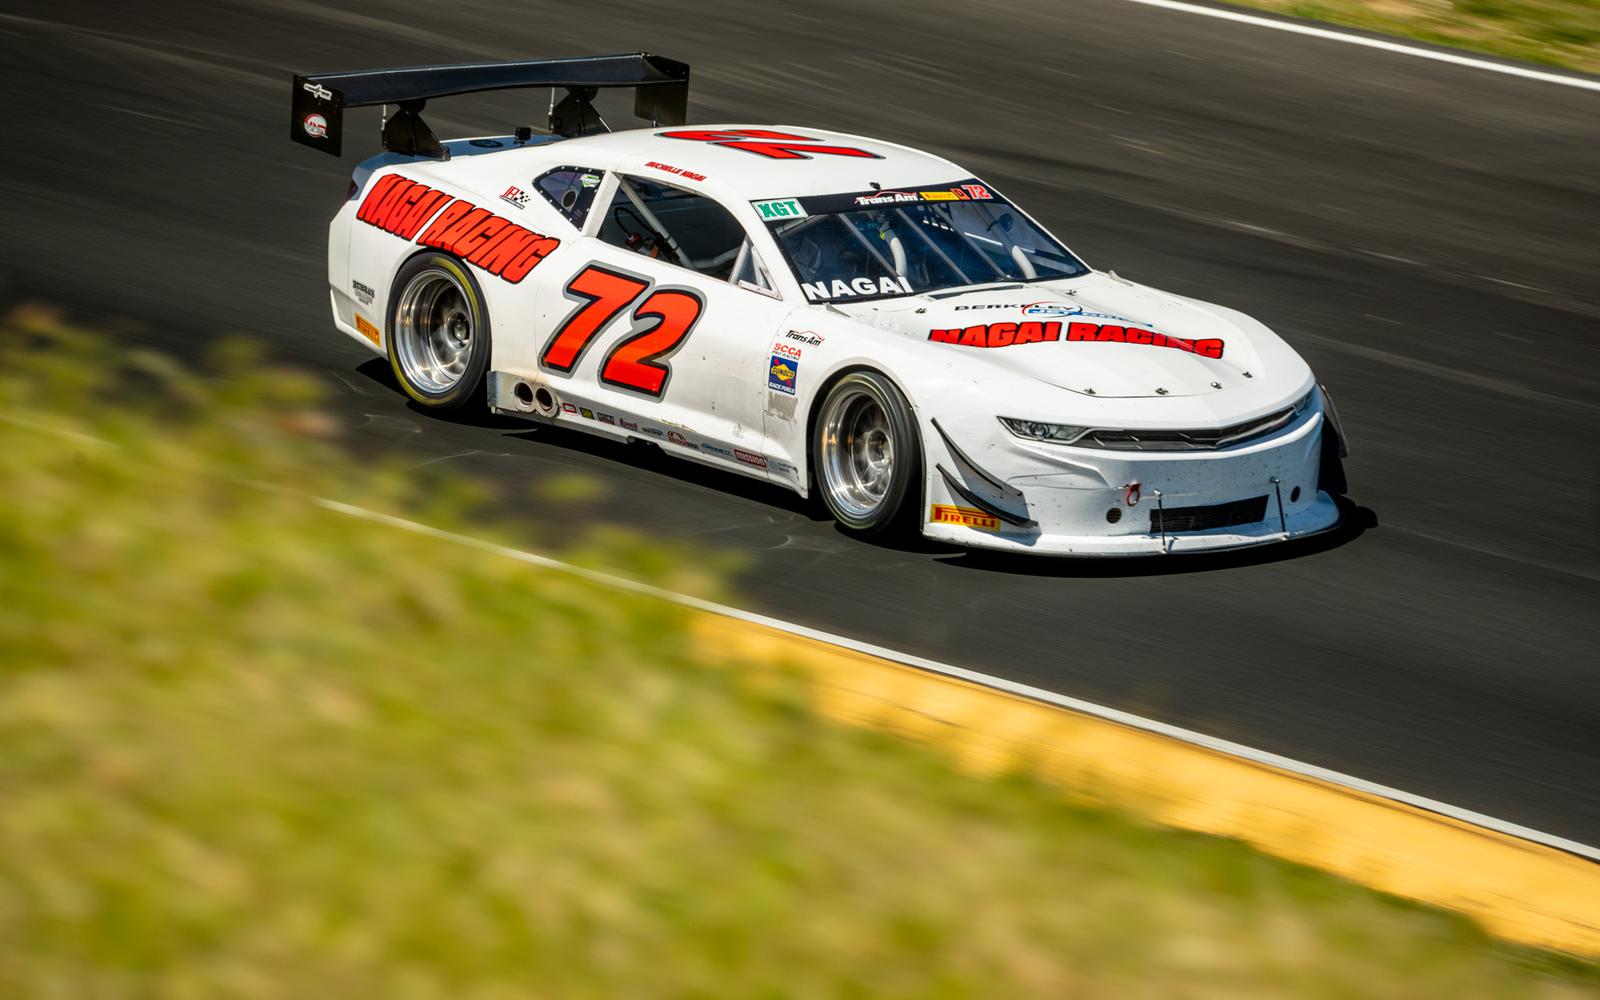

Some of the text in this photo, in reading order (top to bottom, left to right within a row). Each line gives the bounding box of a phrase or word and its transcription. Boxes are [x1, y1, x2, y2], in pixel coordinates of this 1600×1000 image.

[858, 193, 917, 205] Trans Am
[962, 184, 993, 199] 72
[757, 200, 800, 218] XGT
[356, 173, 561, 284] NAGAI RACING
[801, 276, 914, 300] NAGAI
[538, 260, 707, 403] 72
[786, 330, 821, 345] Trans Am
[928, 321, 1224, 359] NAGAI RACING
[774, 343, 801, 356] SCCA
[772, 367, 795, 378] SUNOCO
[935, 507, 996, 528] PIRELLI
